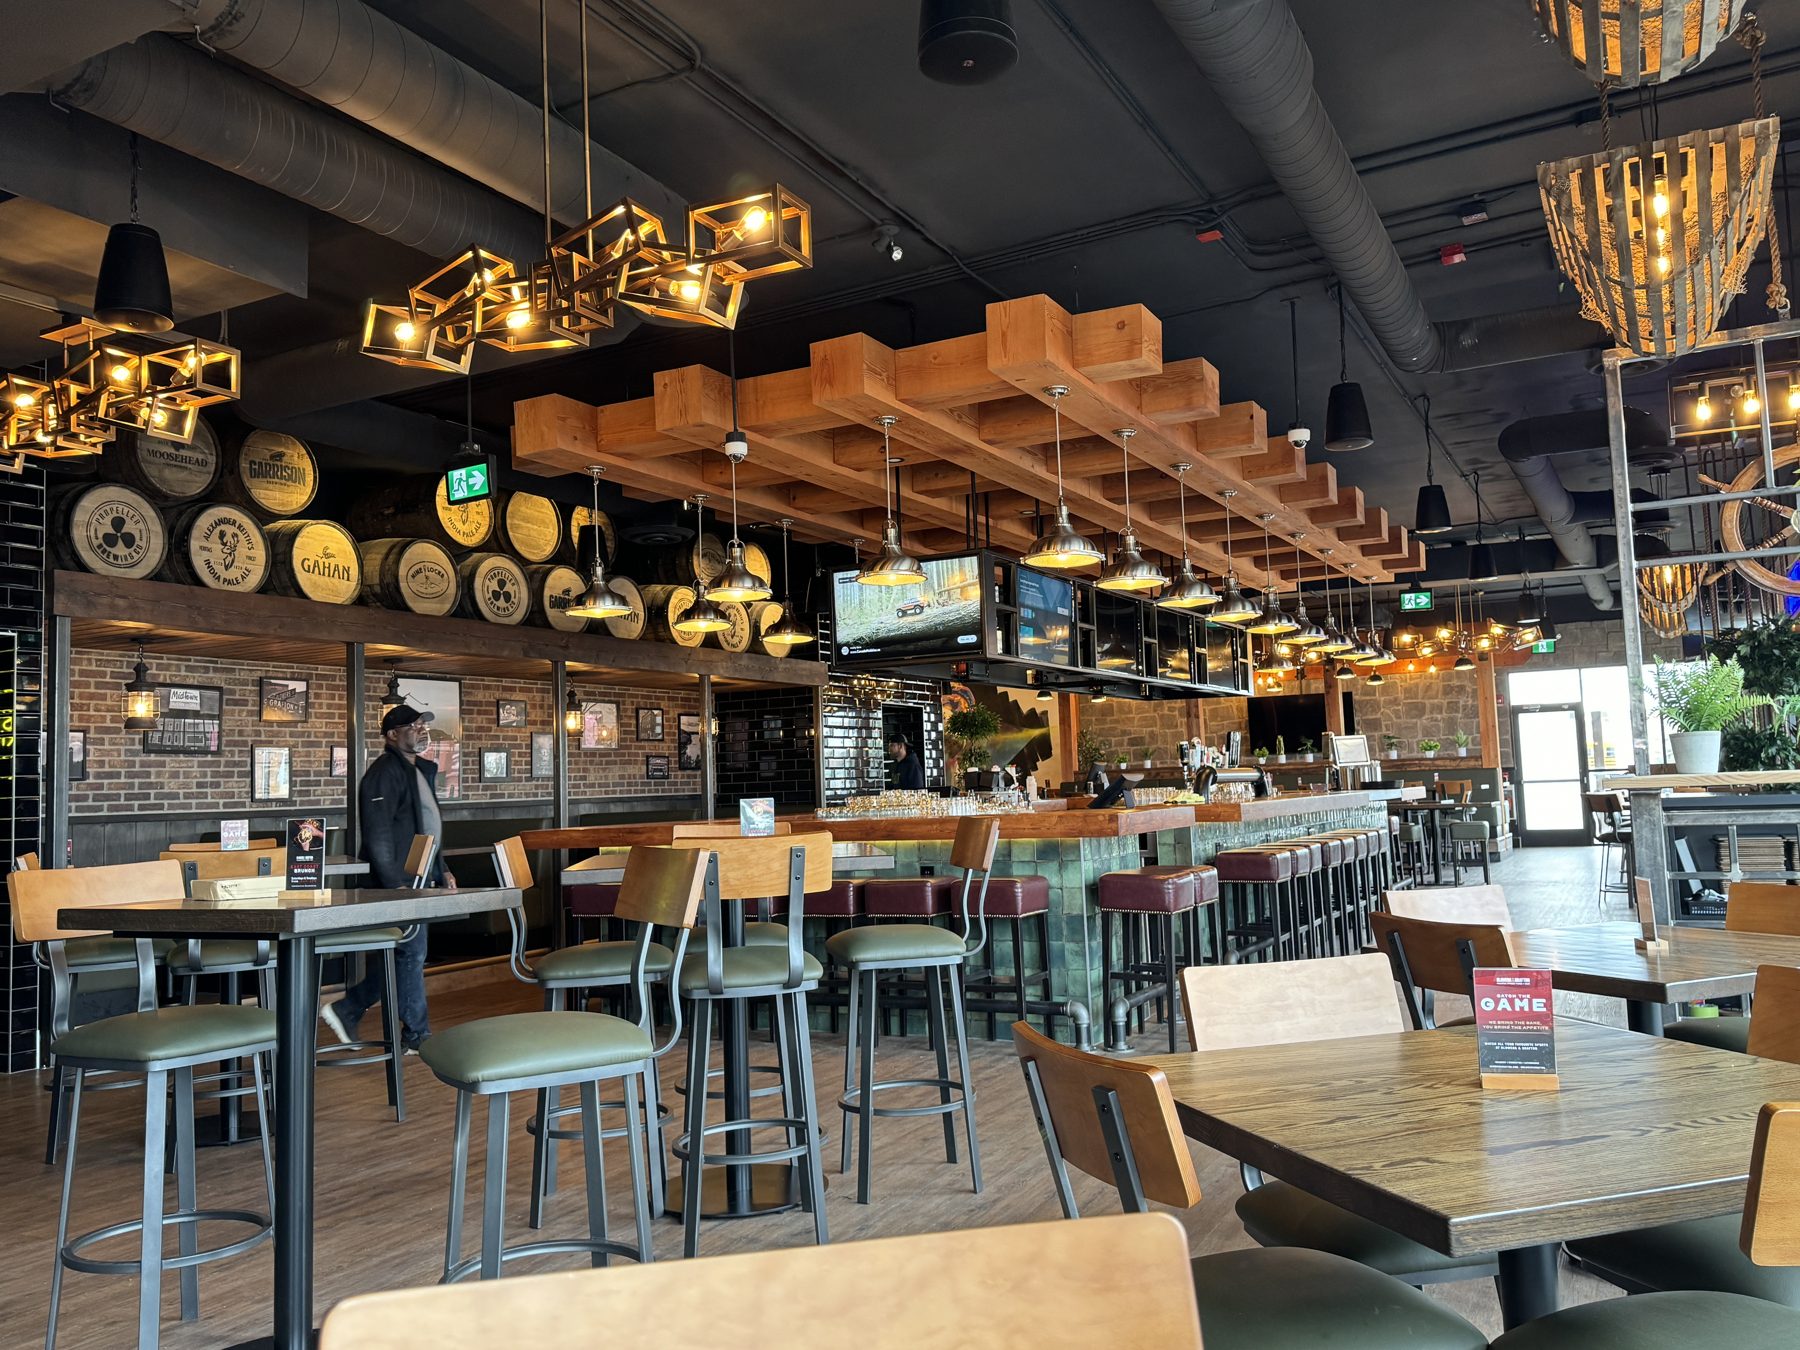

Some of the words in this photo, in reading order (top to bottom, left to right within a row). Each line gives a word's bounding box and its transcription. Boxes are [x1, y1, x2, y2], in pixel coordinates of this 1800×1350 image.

[147, 448, 208, 467] MOOSEHEAD
[249, 459, 306, 487] GARRISON
[94, 506, 141, 526] PROPELLER
[203, 517, 237, 541] ALEXANDER
[236, 523, 255, 551] KEITH'S
[448, 517, 461, 536] INDIA
[462, 531, 476, 539] PALE
[96, 543, 135, 562] BREWING
[203, 559, 221, 583] INDIA
[222, 577, 242, 587] PALE
[241, 566, 252, 581] ALE
[301, 557, 351, 582] GAHAN
[488, 571, 516, 587] PROPELLER
[1480, 997, 1547, 1012] GAME
